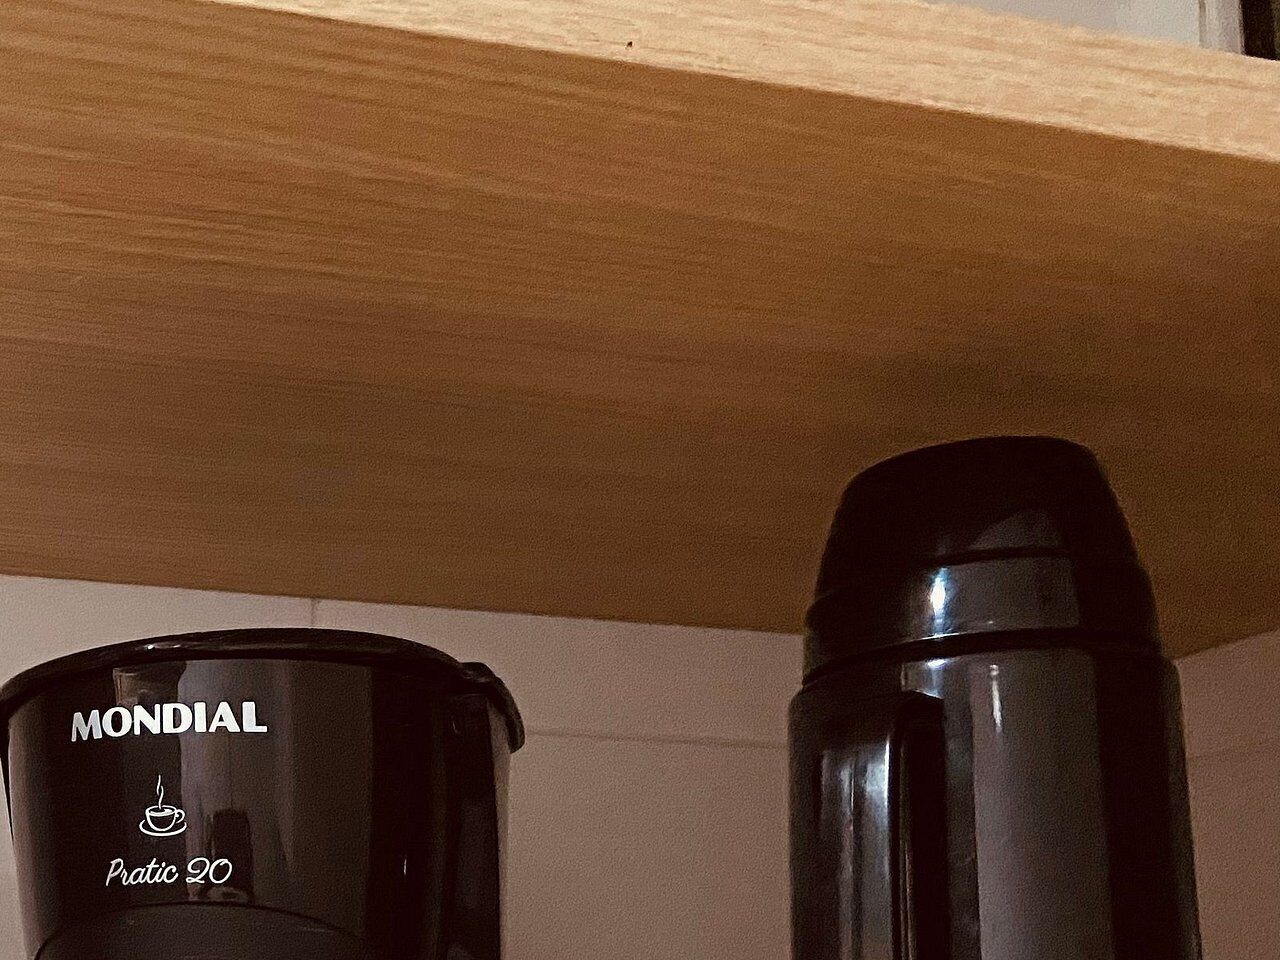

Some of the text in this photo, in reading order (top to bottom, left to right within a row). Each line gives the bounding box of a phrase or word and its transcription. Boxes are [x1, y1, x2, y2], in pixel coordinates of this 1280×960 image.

[71, 701, 268, 742] MONDIAL
[105, 857, 233, 887] Pratic 20
